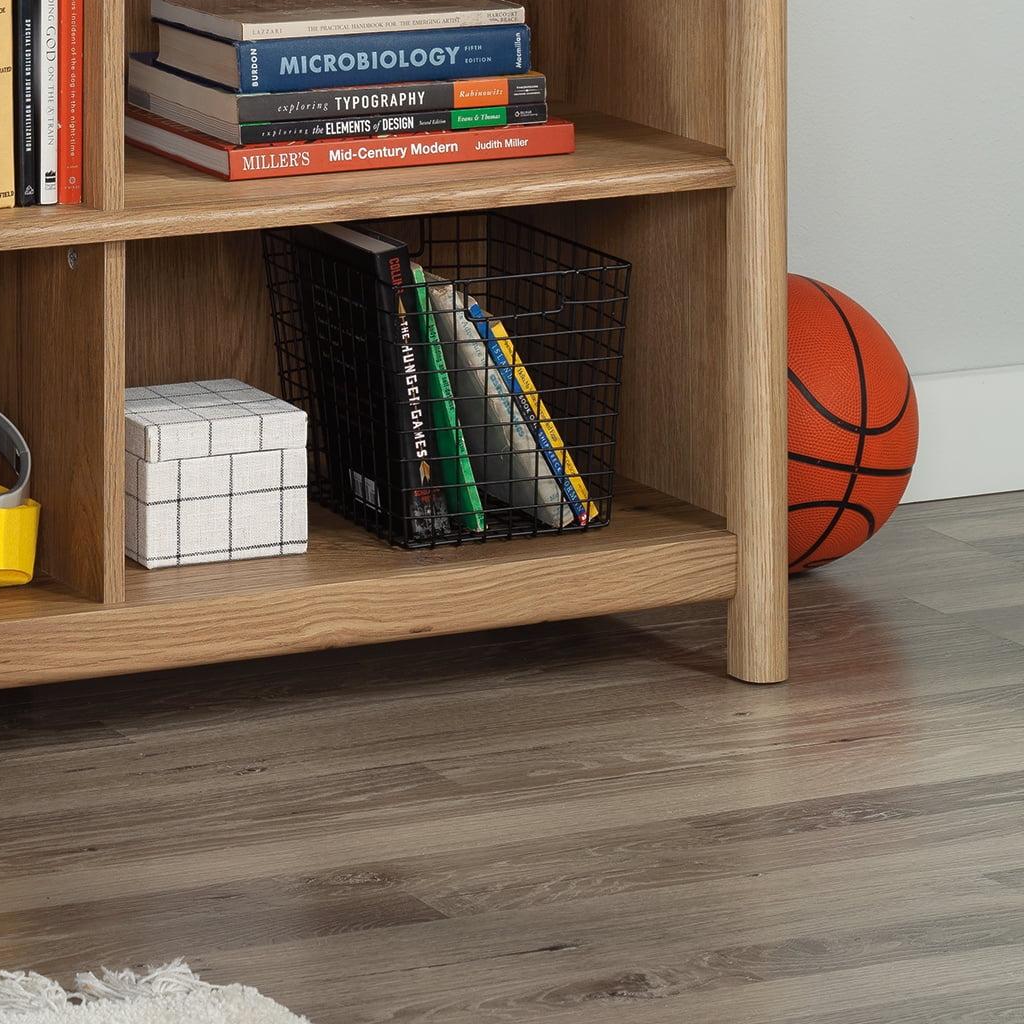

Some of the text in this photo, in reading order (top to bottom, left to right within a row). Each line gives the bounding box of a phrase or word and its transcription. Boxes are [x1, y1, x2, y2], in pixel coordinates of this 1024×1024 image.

[46, 26, 56, 62] GOD
[250, 48, 259, 87] BURDON
[279, 46, 460, 75] MICROBIOLOGY
[48, 66, 55, 81] ON
[277, 91, 425, 113] exploring TYPOGRAPHY
[459, 88, 503, 98] Rabinowitz
[312, 125, 324, 135] the
[325, 120, 371, 135] ELEMENTS
[373, 121, 381, 132] of
[382, 116, 414, 131] DESIGN
[242, 142, 458, 171] MILLER'S Mid-Century Modern
[475, 138, 528, 151] Judith Miller
[400, 321, 410, 339] THE
[410, 409, 428, 458] GAMES
